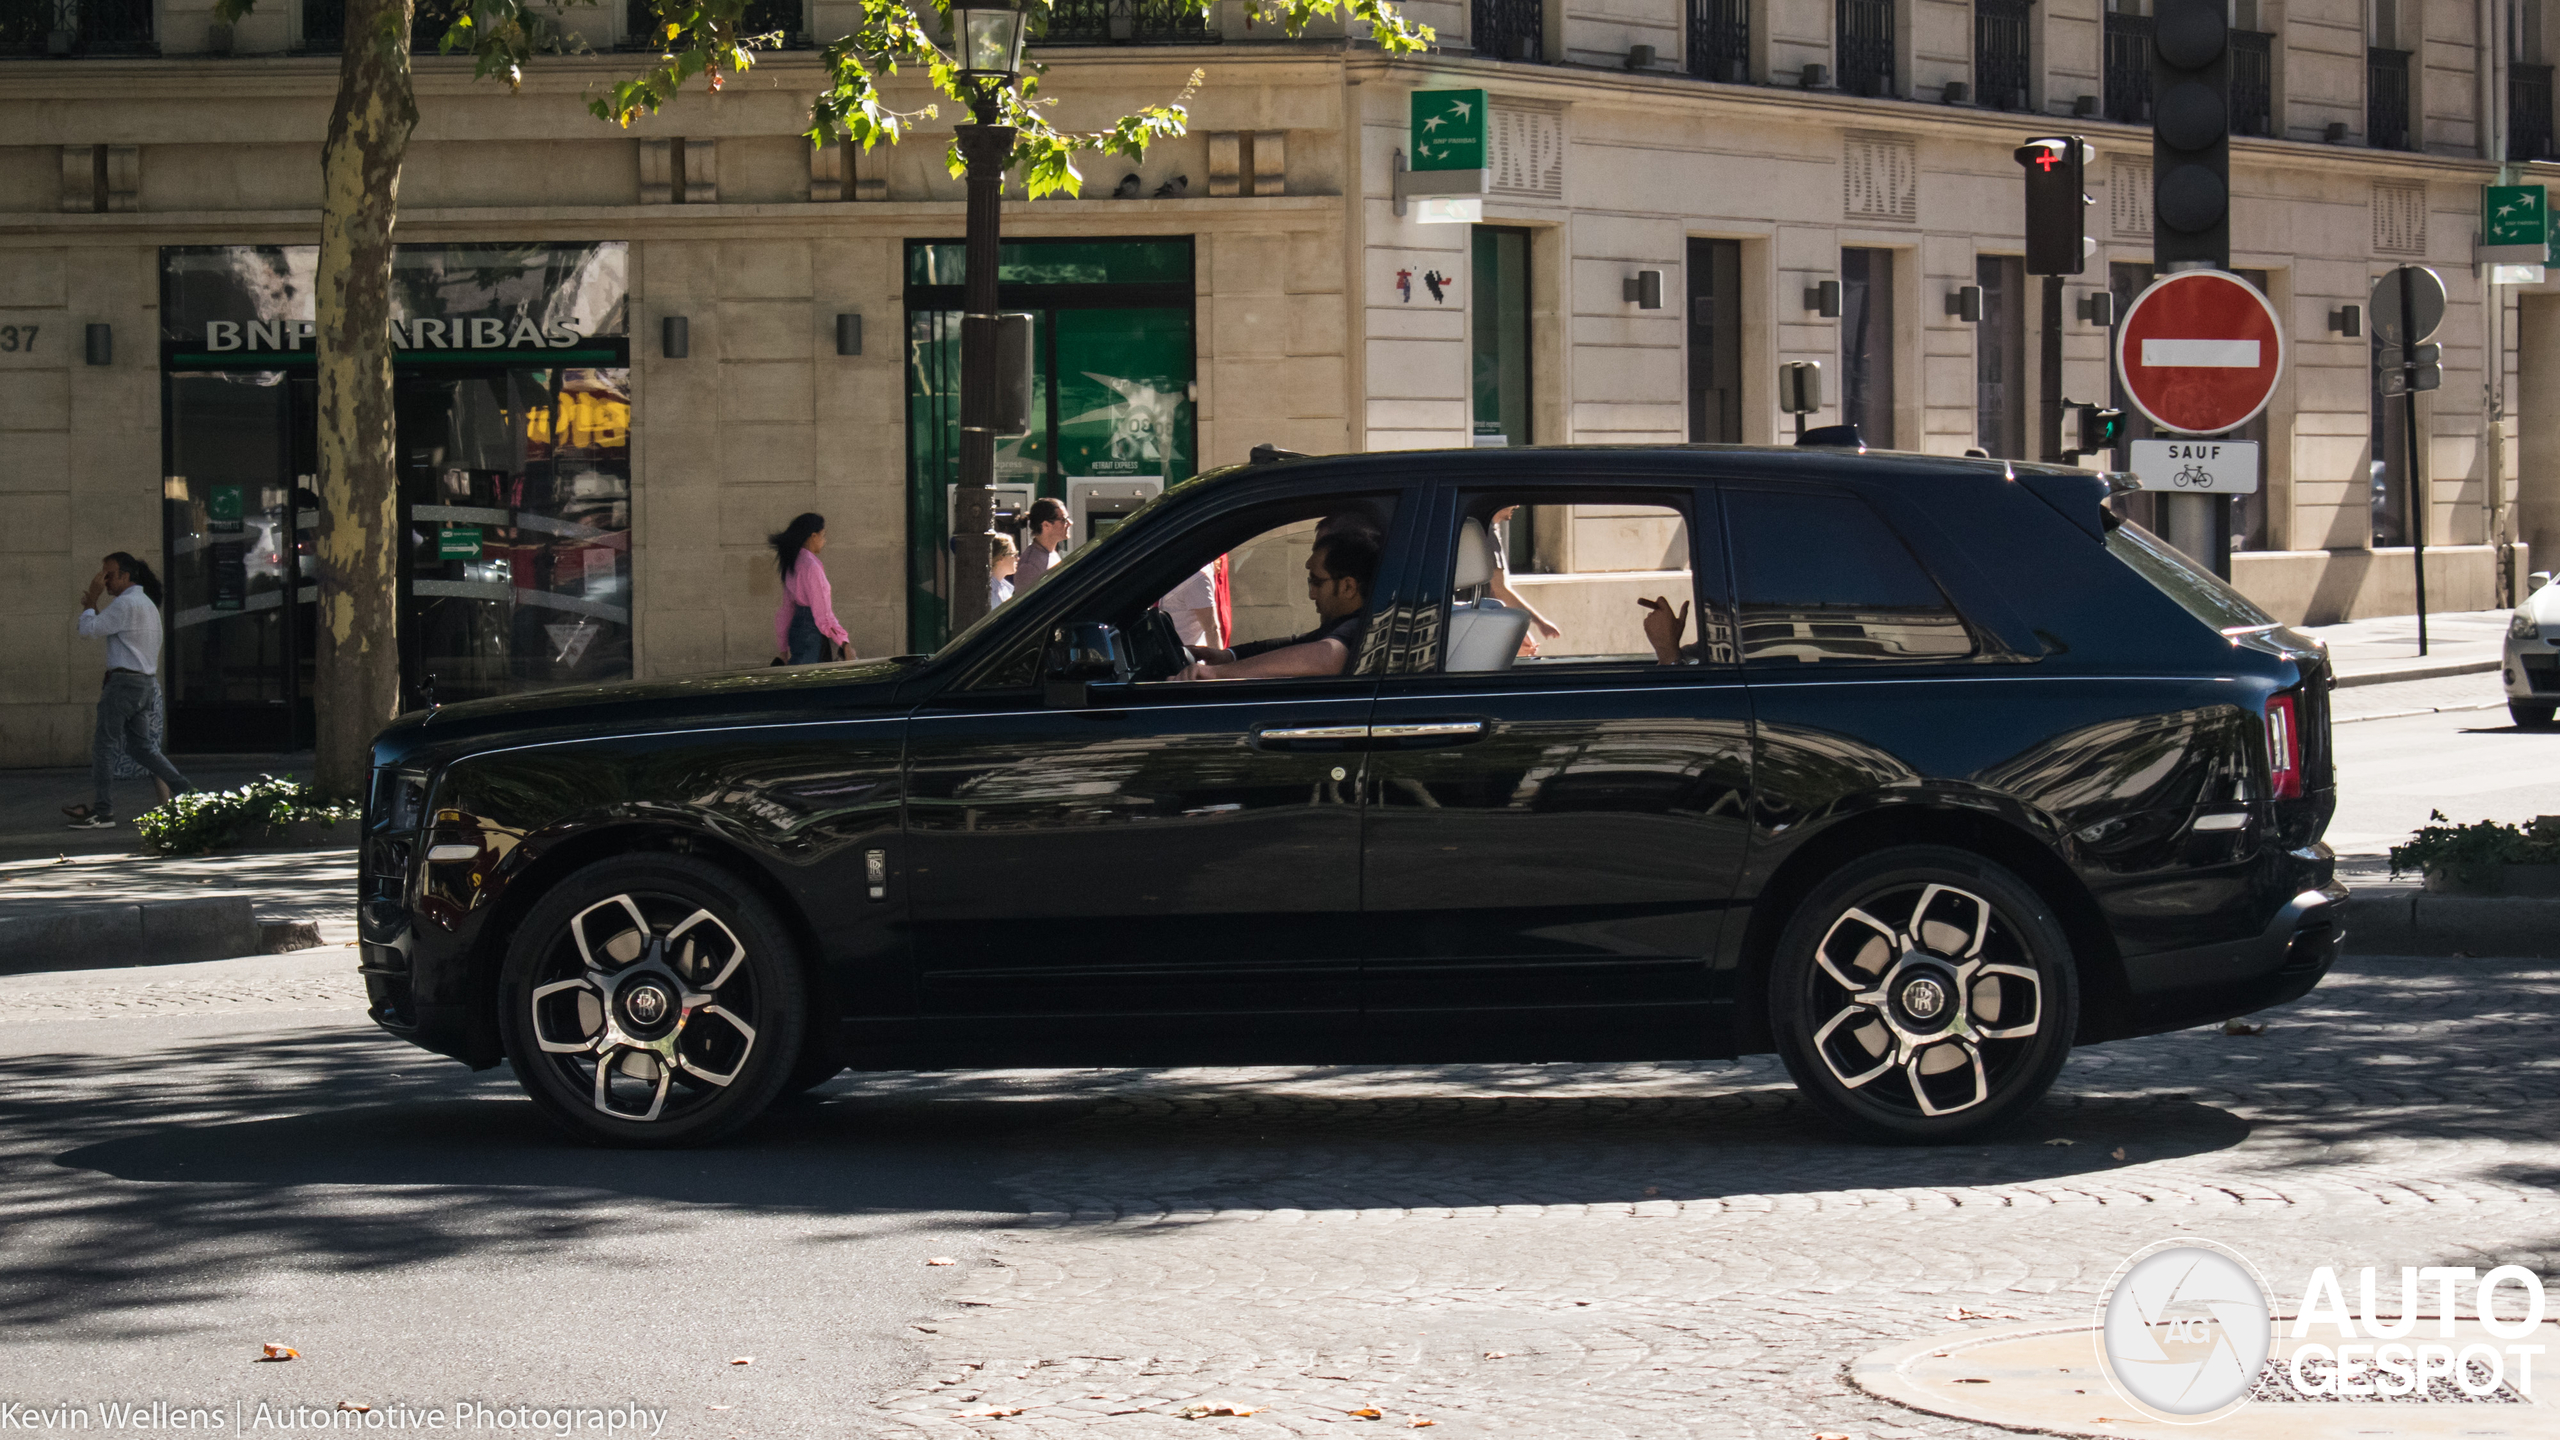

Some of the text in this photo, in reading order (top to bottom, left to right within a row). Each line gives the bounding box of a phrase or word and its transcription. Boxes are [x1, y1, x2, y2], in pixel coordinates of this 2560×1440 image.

[1848, 143, 1912, 213] BNP
[1, 325, 39, 352] 37
[207, 316, 580, 351] BNP ARIBAS
[1091, 461, 1138, 469] RETRAIT EXPRESS
[2169, 445, 2221, 459] SAUF
